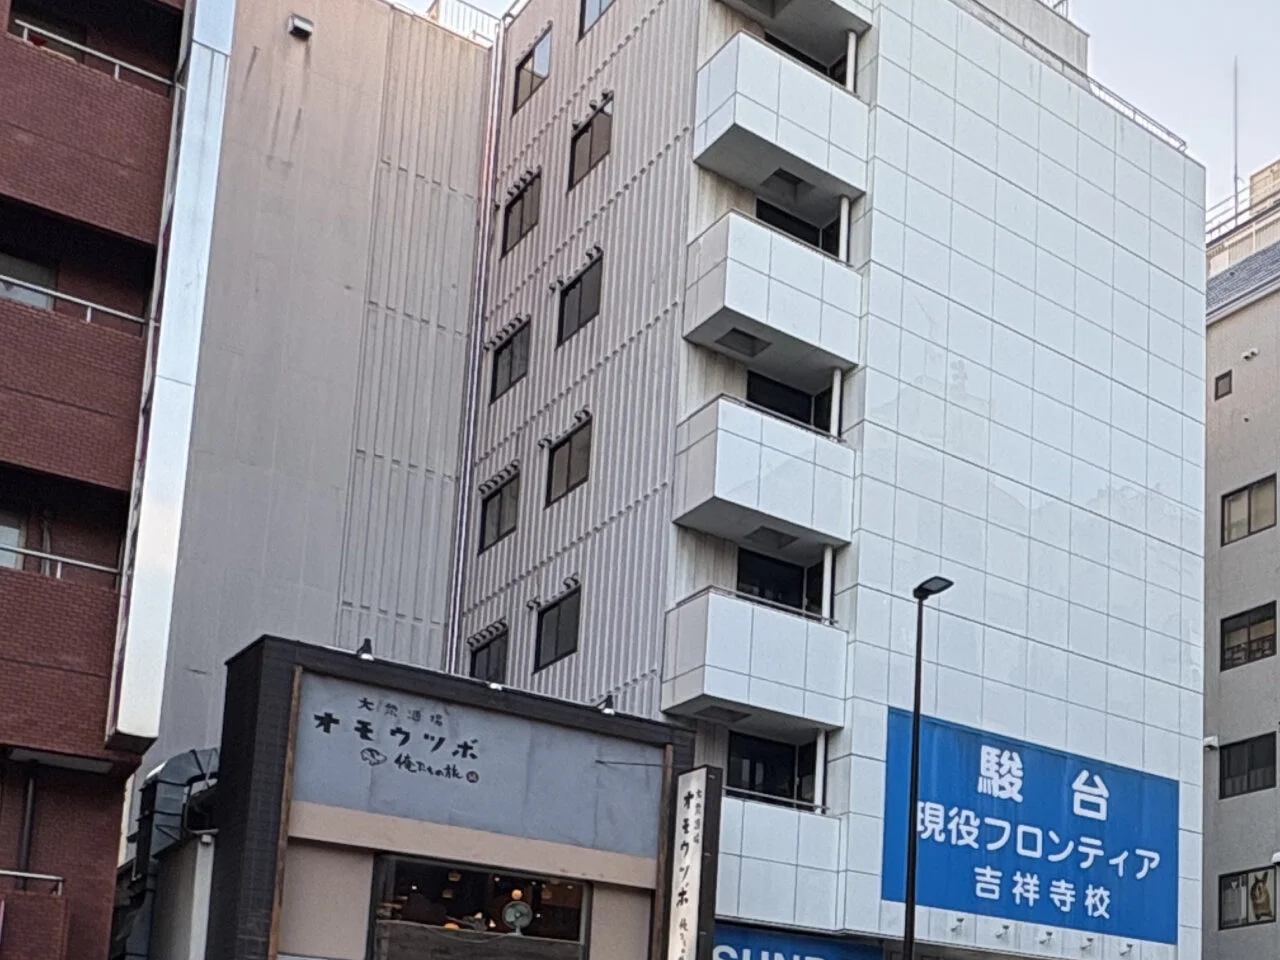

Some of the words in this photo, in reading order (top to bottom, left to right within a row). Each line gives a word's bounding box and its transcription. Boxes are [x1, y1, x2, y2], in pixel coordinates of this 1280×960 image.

[313, 711, 479, 760] オモウツボ
[977, 744, 1110, 822] 駿台
[676, 790, 695, 908] オモウツボ
[916, 799, 1161, 881] 現役フロンティア
[973, 865, 1112, 920] 吉祥寺校
